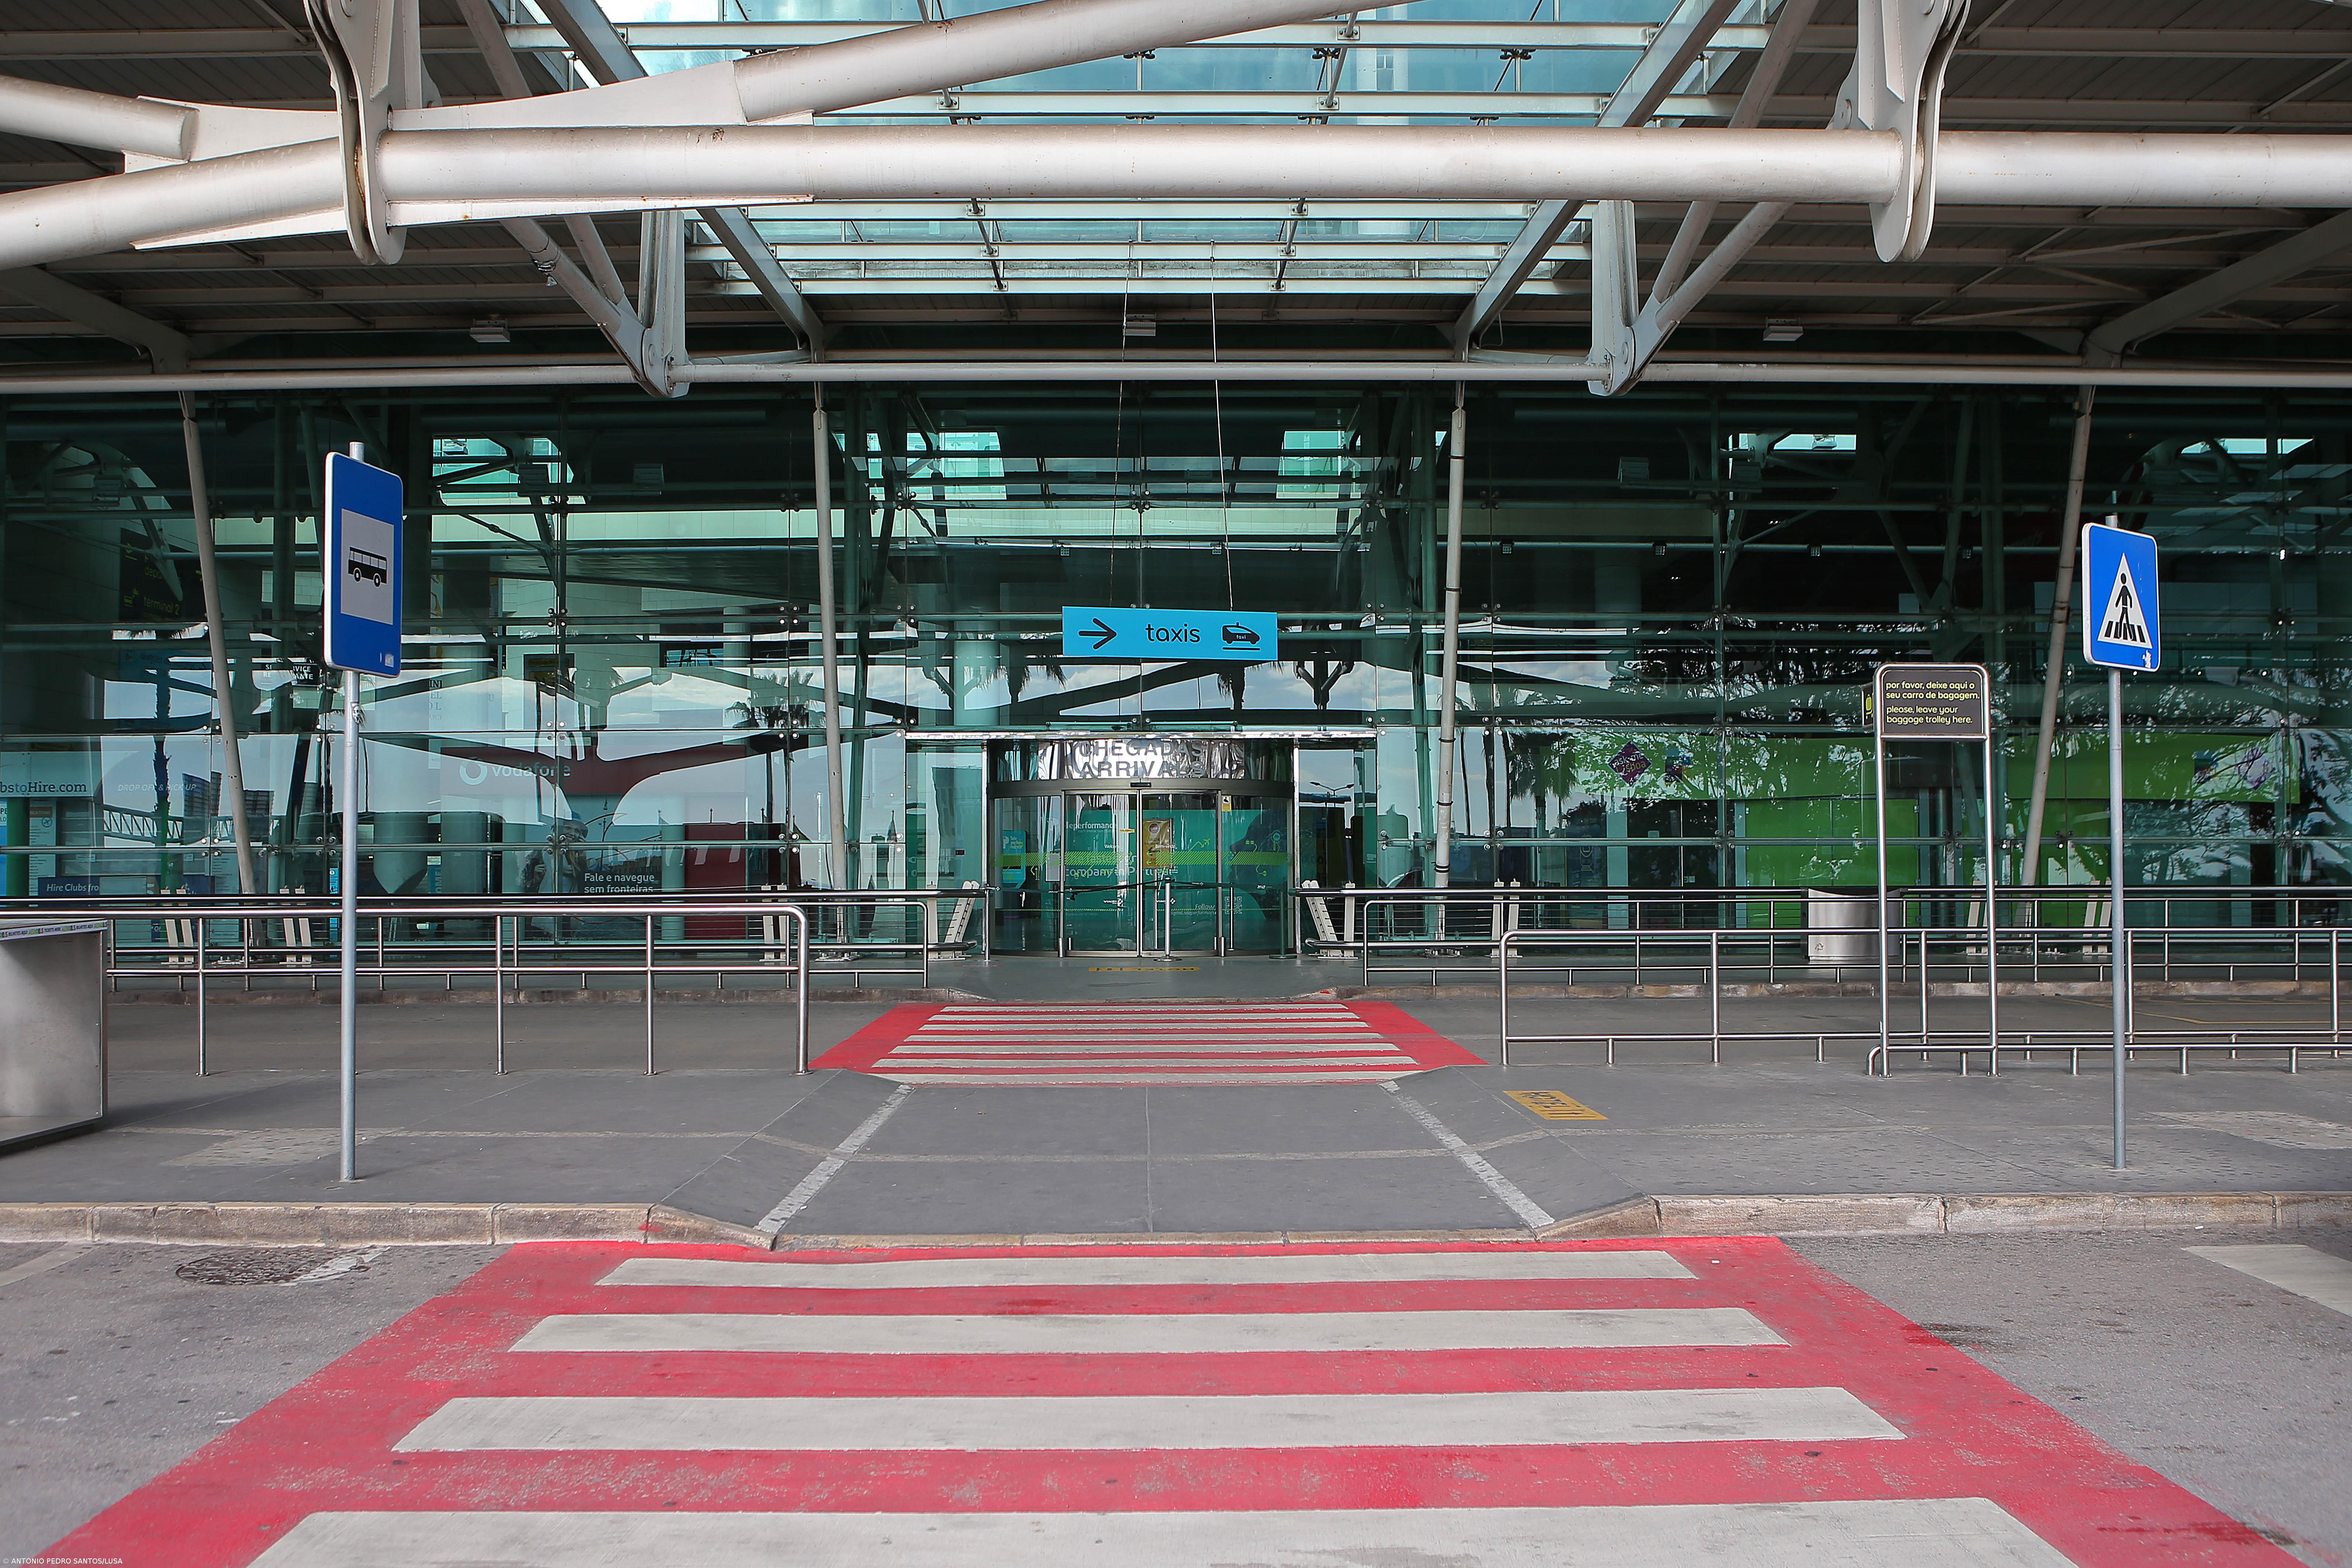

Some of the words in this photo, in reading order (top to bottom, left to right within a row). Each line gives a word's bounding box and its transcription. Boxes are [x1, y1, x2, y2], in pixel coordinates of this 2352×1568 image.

[1145, 623, 1200, 642] taxis
[1886, 682, 1900, 690] por
[1901, 681, 1924, 690] favor,
[1926, 681, 1947, 689] deixe
[1949, 681, 1967, 690] aqui
[1938, 691, 1980, 700] bagagem.
[1887, 705, 1914, 714] please,
[1939, 707, 1958, 715] your
[1887, 716, 1923, 725] baggage
[1925, 716, 1950, 725] trolley
[1080, 740, 1203, 757] CHEGADAS
[1081, 760, 1205, 777] ARRIVALS
[584, 873, 604, 881] Fale
[614, 875, 655, 884] navegue
[88, 884, 99, 892] fro
[607, 885, 653, 893] fronteiras
